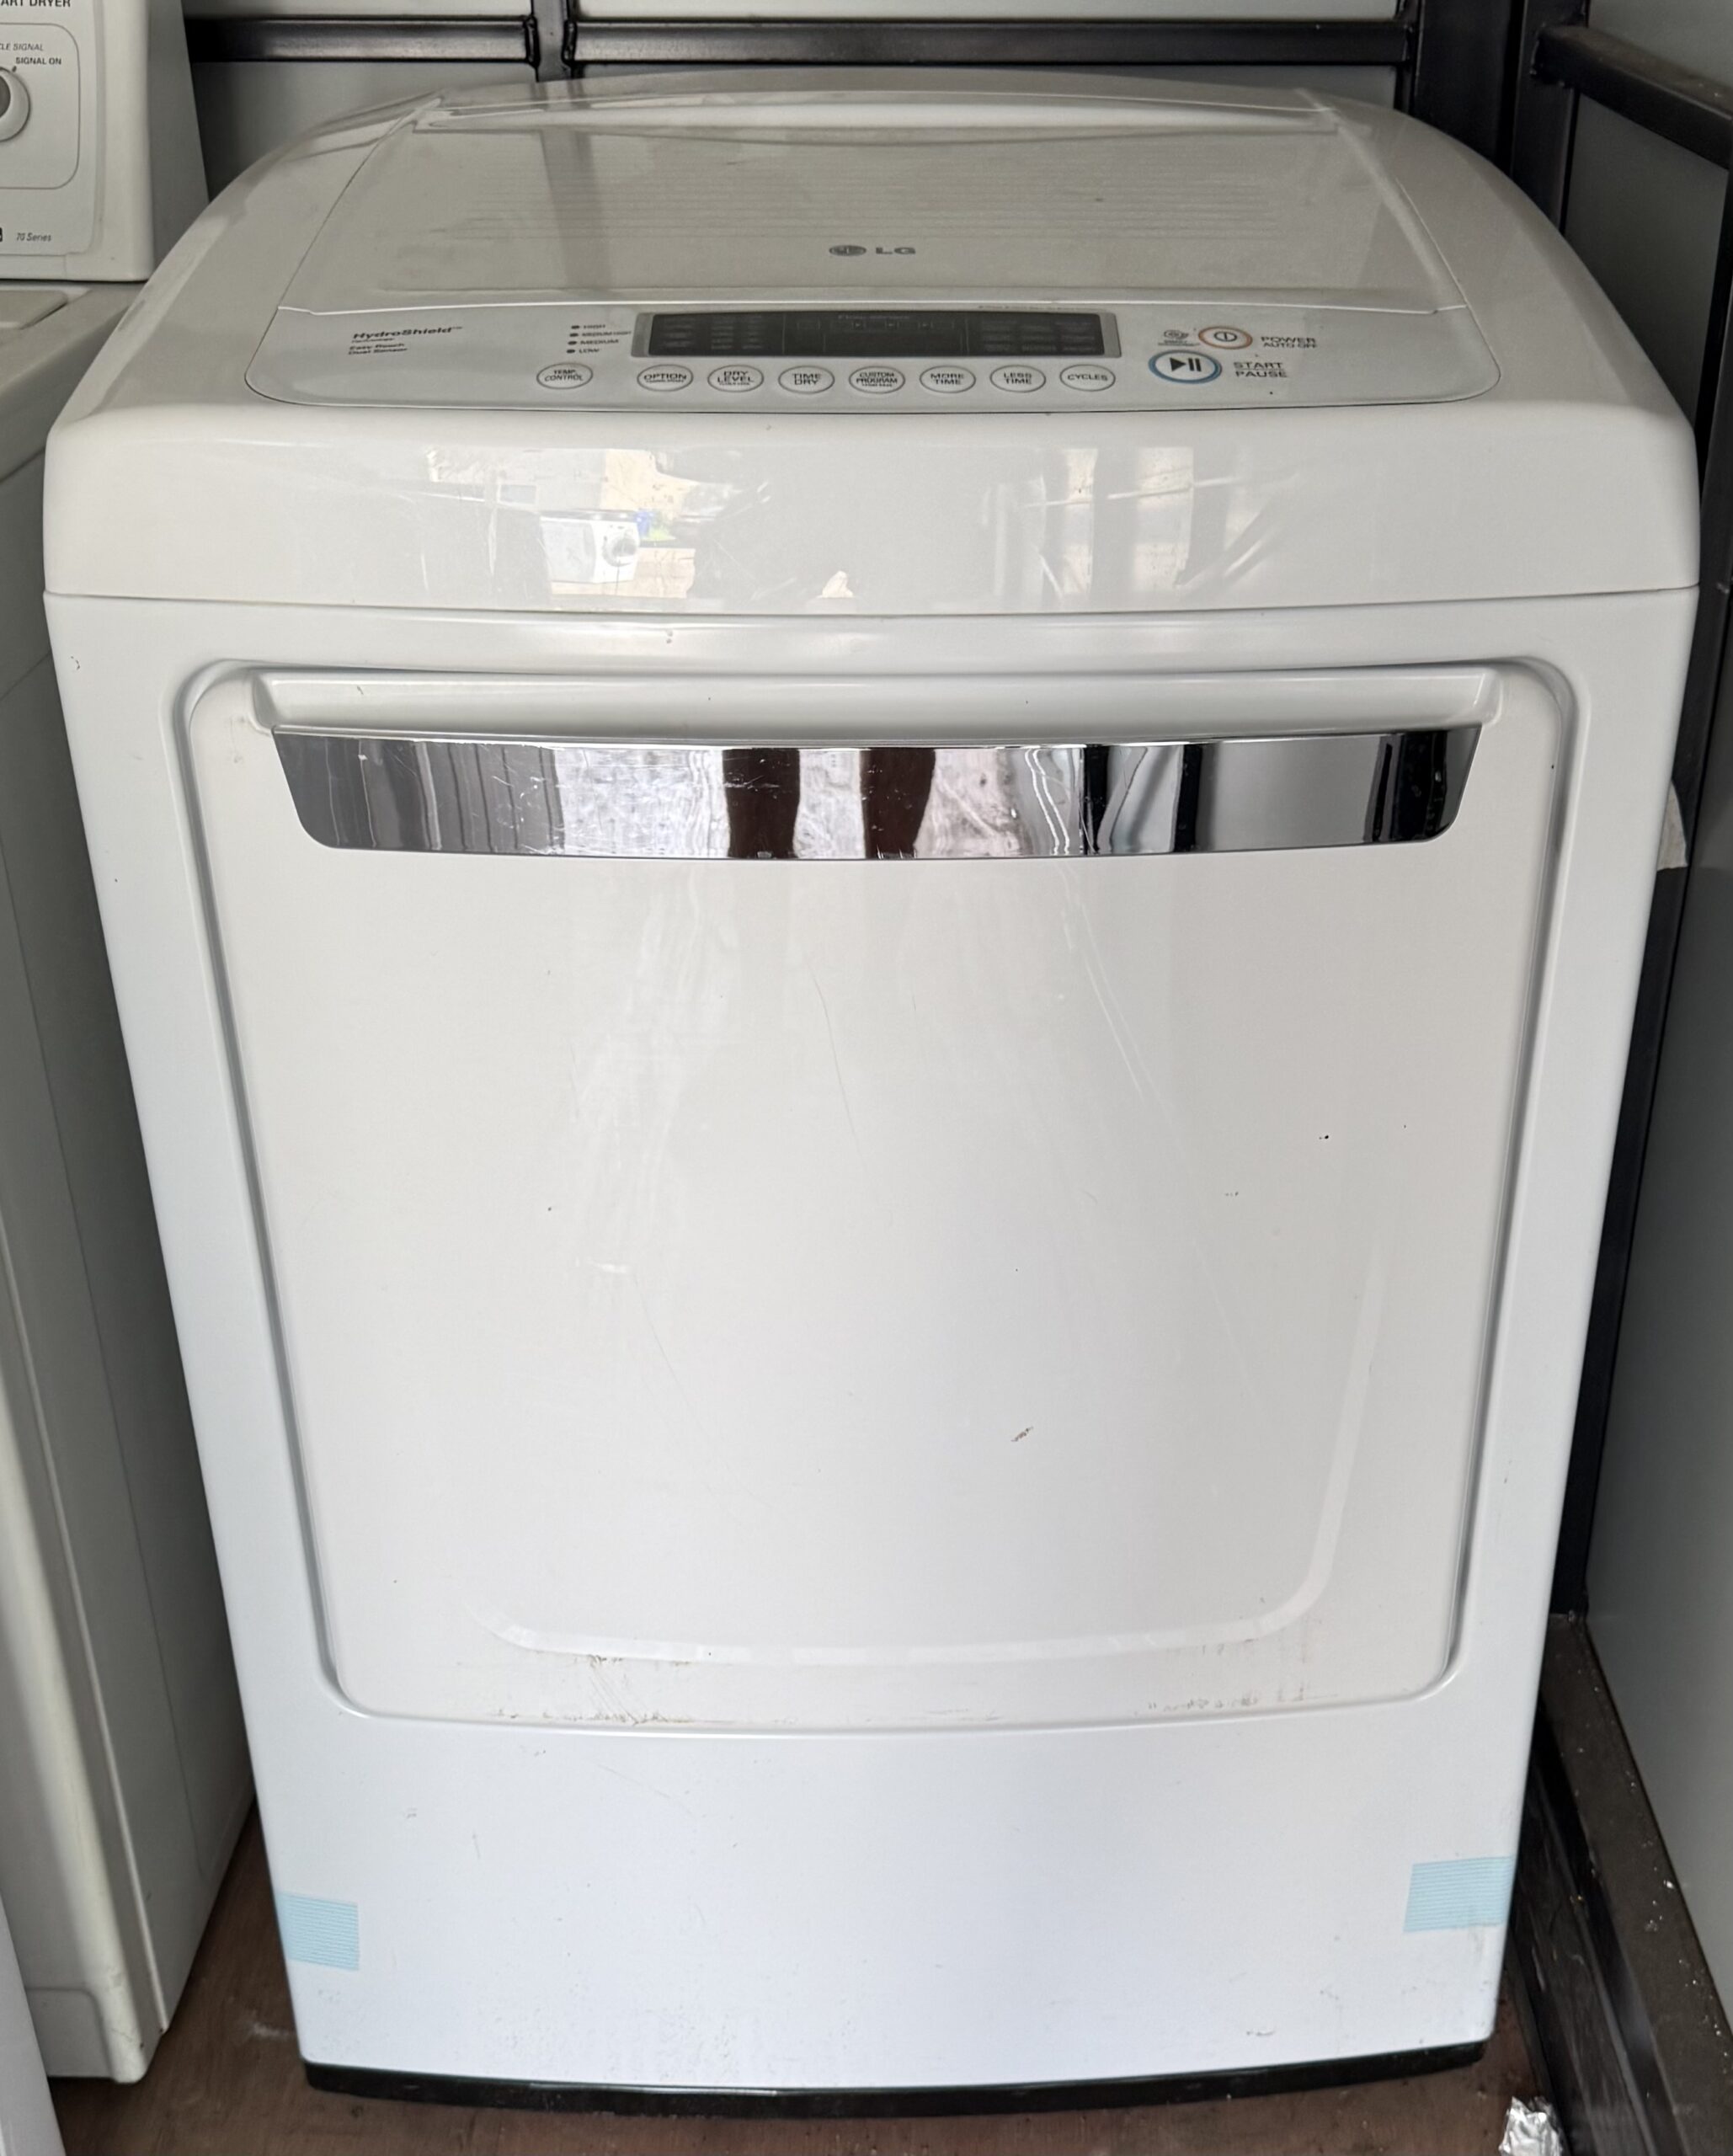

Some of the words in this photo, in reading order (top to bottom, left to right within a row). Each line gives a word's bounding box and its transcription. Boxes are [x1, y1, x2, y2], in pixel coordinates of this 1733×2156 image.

[13, 43, 44, 51] SIGNAL
[16, 56, 46, 65] SIGNAL
[27, 232, 51, 242] Series
[544, 373, 584, 382] CONTROL
[1067, 373, 1108, 382] CYCLES
